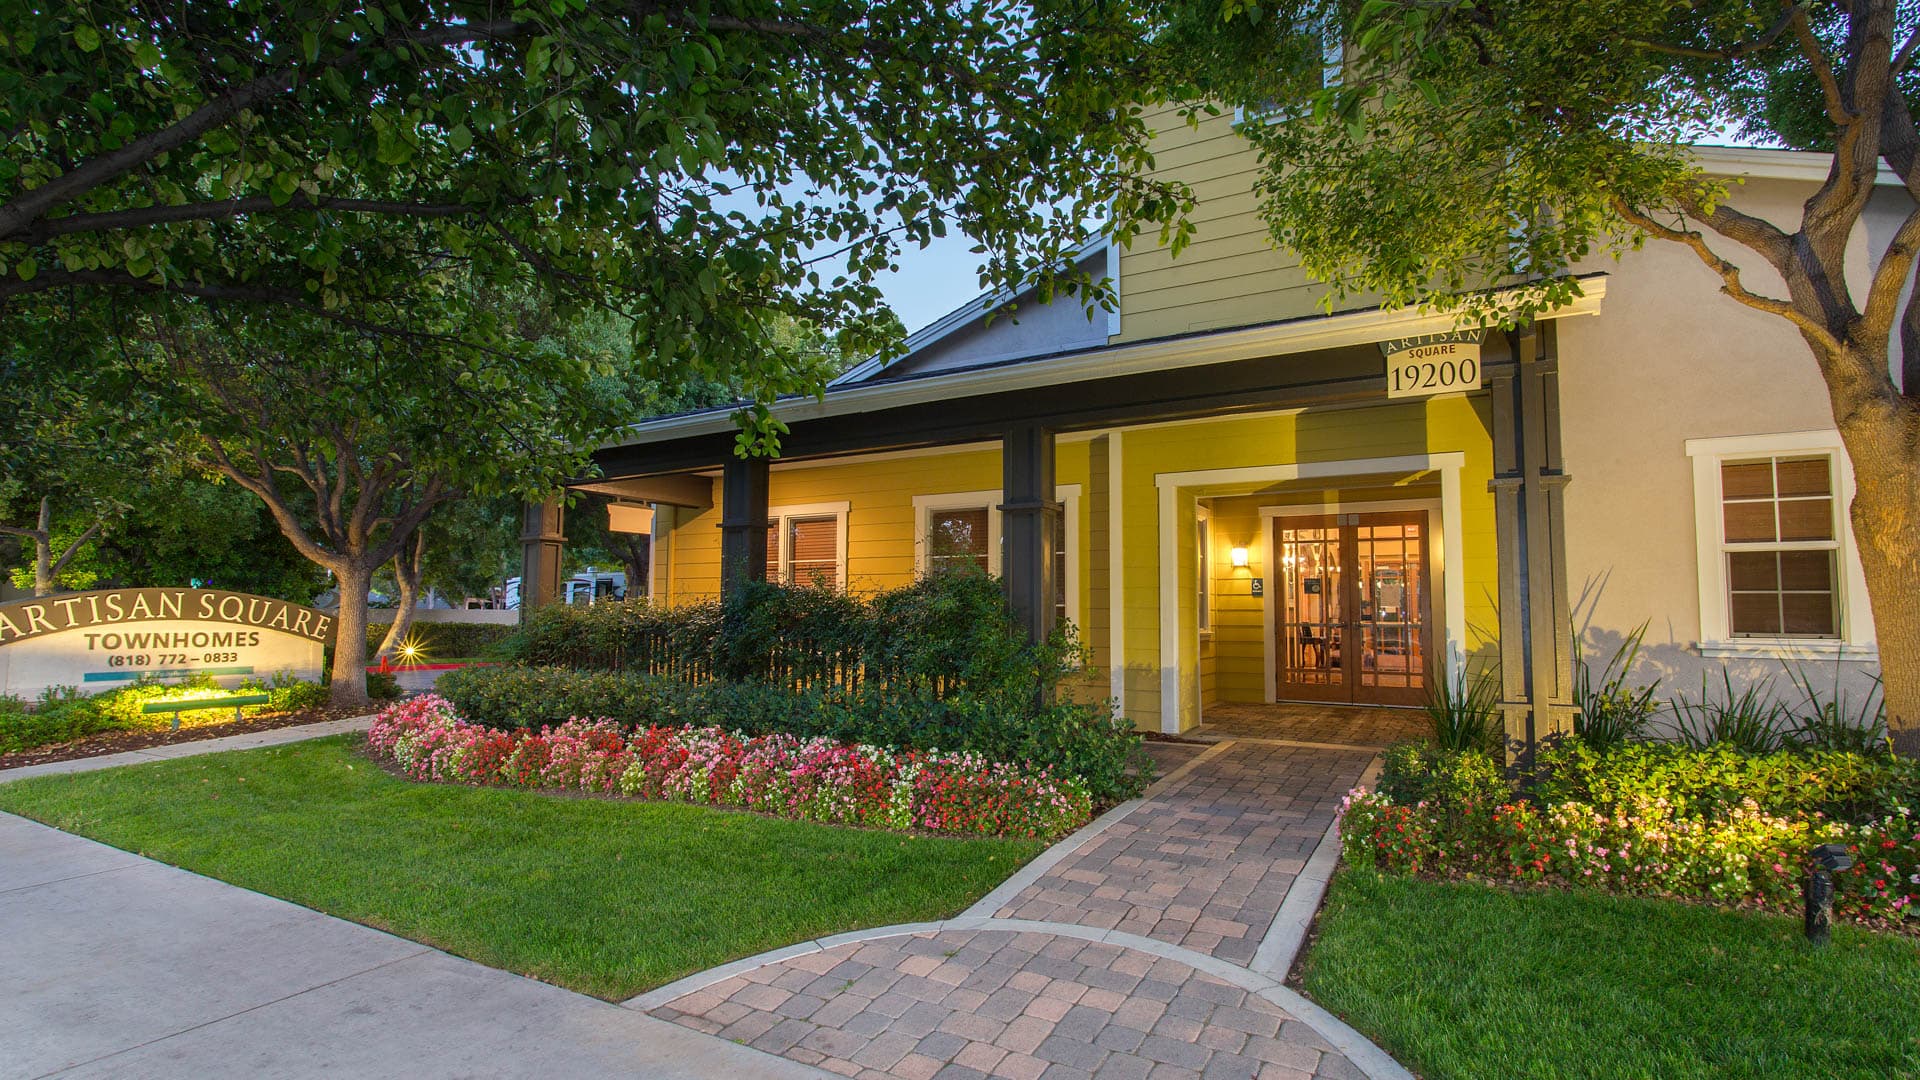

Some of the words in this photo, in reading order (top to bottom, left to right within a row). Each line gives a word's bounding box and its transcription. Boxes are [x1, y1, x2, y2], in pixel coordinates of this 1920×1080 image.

[1409, 344, 1456, 359] SQUARE
[1392, 358, 1476, 392] 19200
[0, 592, 184, 641] ARTISAN
[198, 593, 332, 640] SQUARE
[84, 632, 260, 650] TOWNHOMES
[108, 653, 151, 668] (818)
